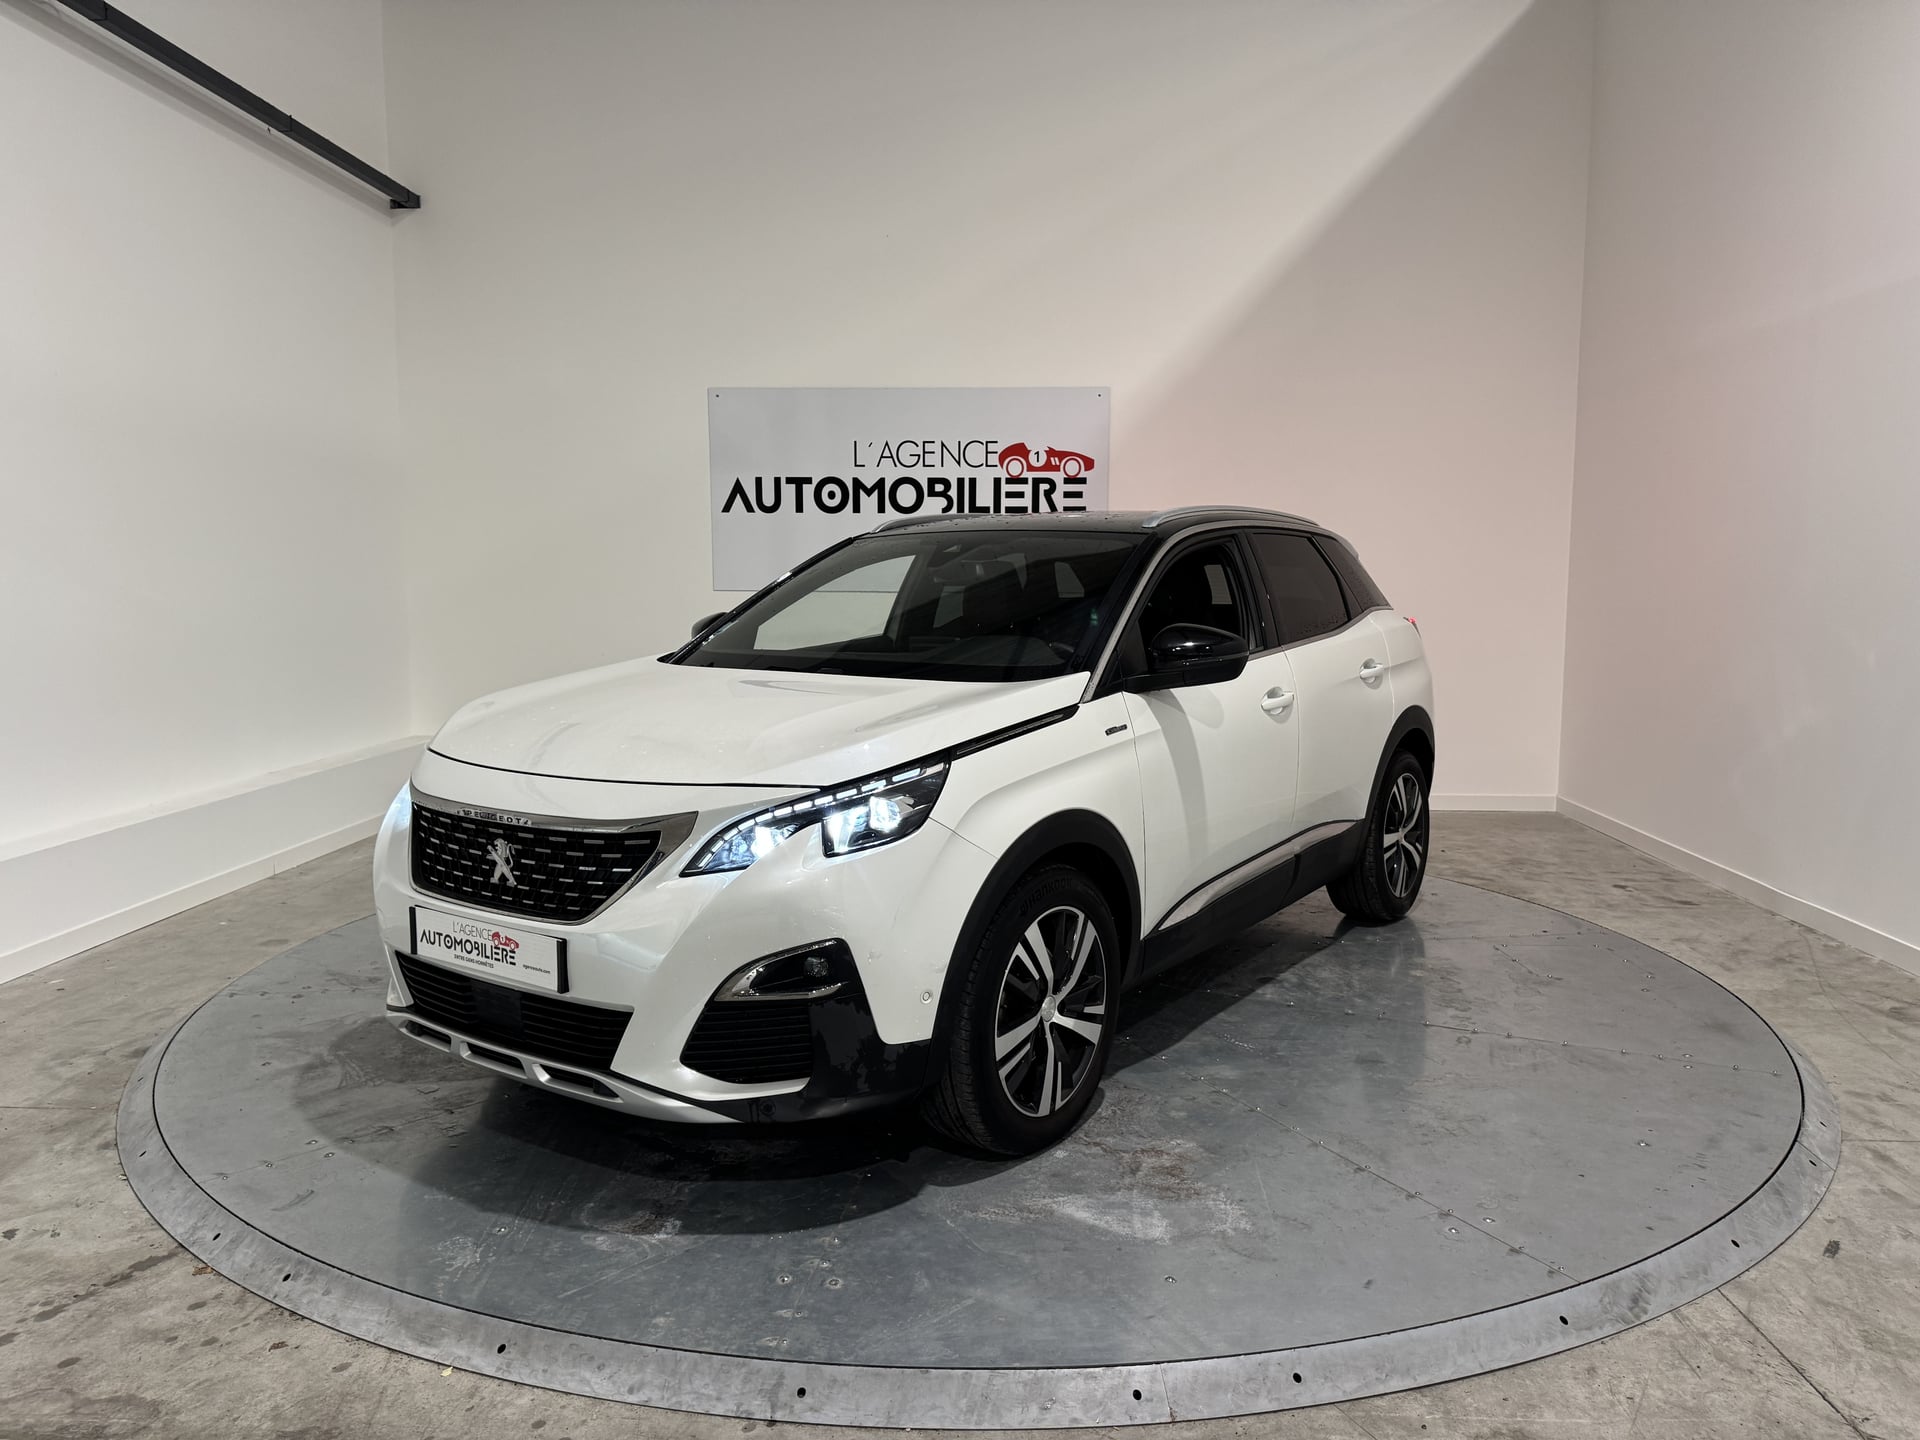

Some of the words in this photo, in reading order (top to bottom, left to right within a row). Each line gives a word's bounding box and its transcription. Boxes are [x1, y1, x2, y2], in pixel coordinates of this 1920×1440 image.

[853, 440, 999, 468] L'AGENCE
[1034, 450, 1040, 463] 1
[721, 476, 1087, 514] AUTOMOBILIERE
[462, 808, 522, 825] PEUGEOT
[452, 920, 493, 942] L'AGENCE
[420, 928, 517, 966] AUTOMOBILIERE
